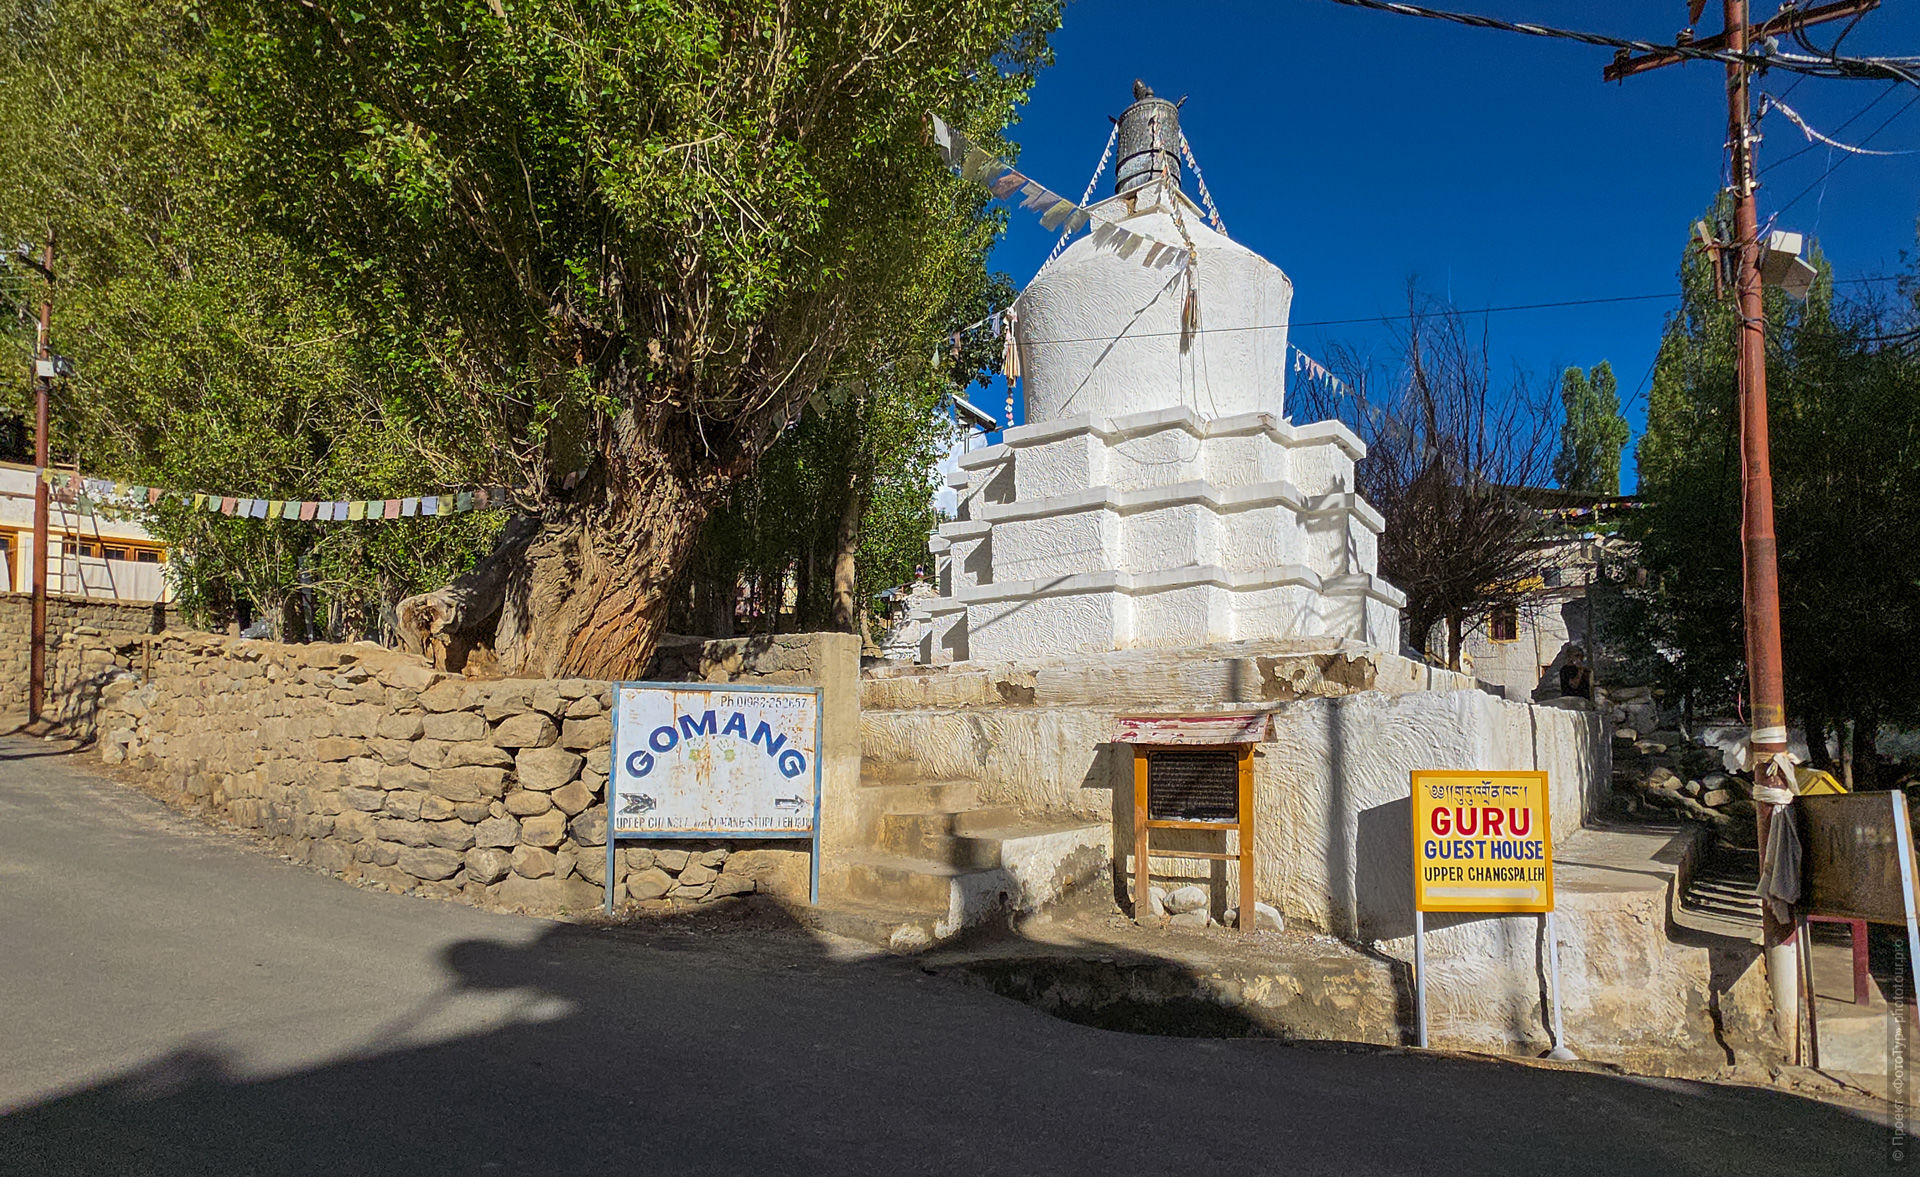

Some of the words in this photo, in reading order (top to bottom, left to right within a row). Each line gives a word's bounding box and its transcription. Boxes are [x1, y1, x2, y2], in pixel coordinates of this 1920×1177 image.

[720, 696, 734, 708] Ph
[626, 710, 806, 779] GOMANG
[1431, 806, 1530, 837] GURU
[1424, 840, 1487, 859] GUEST
[1490, 840, 1544, 861] HOUSE
[1424, 867, 1464, 882] UPPER
